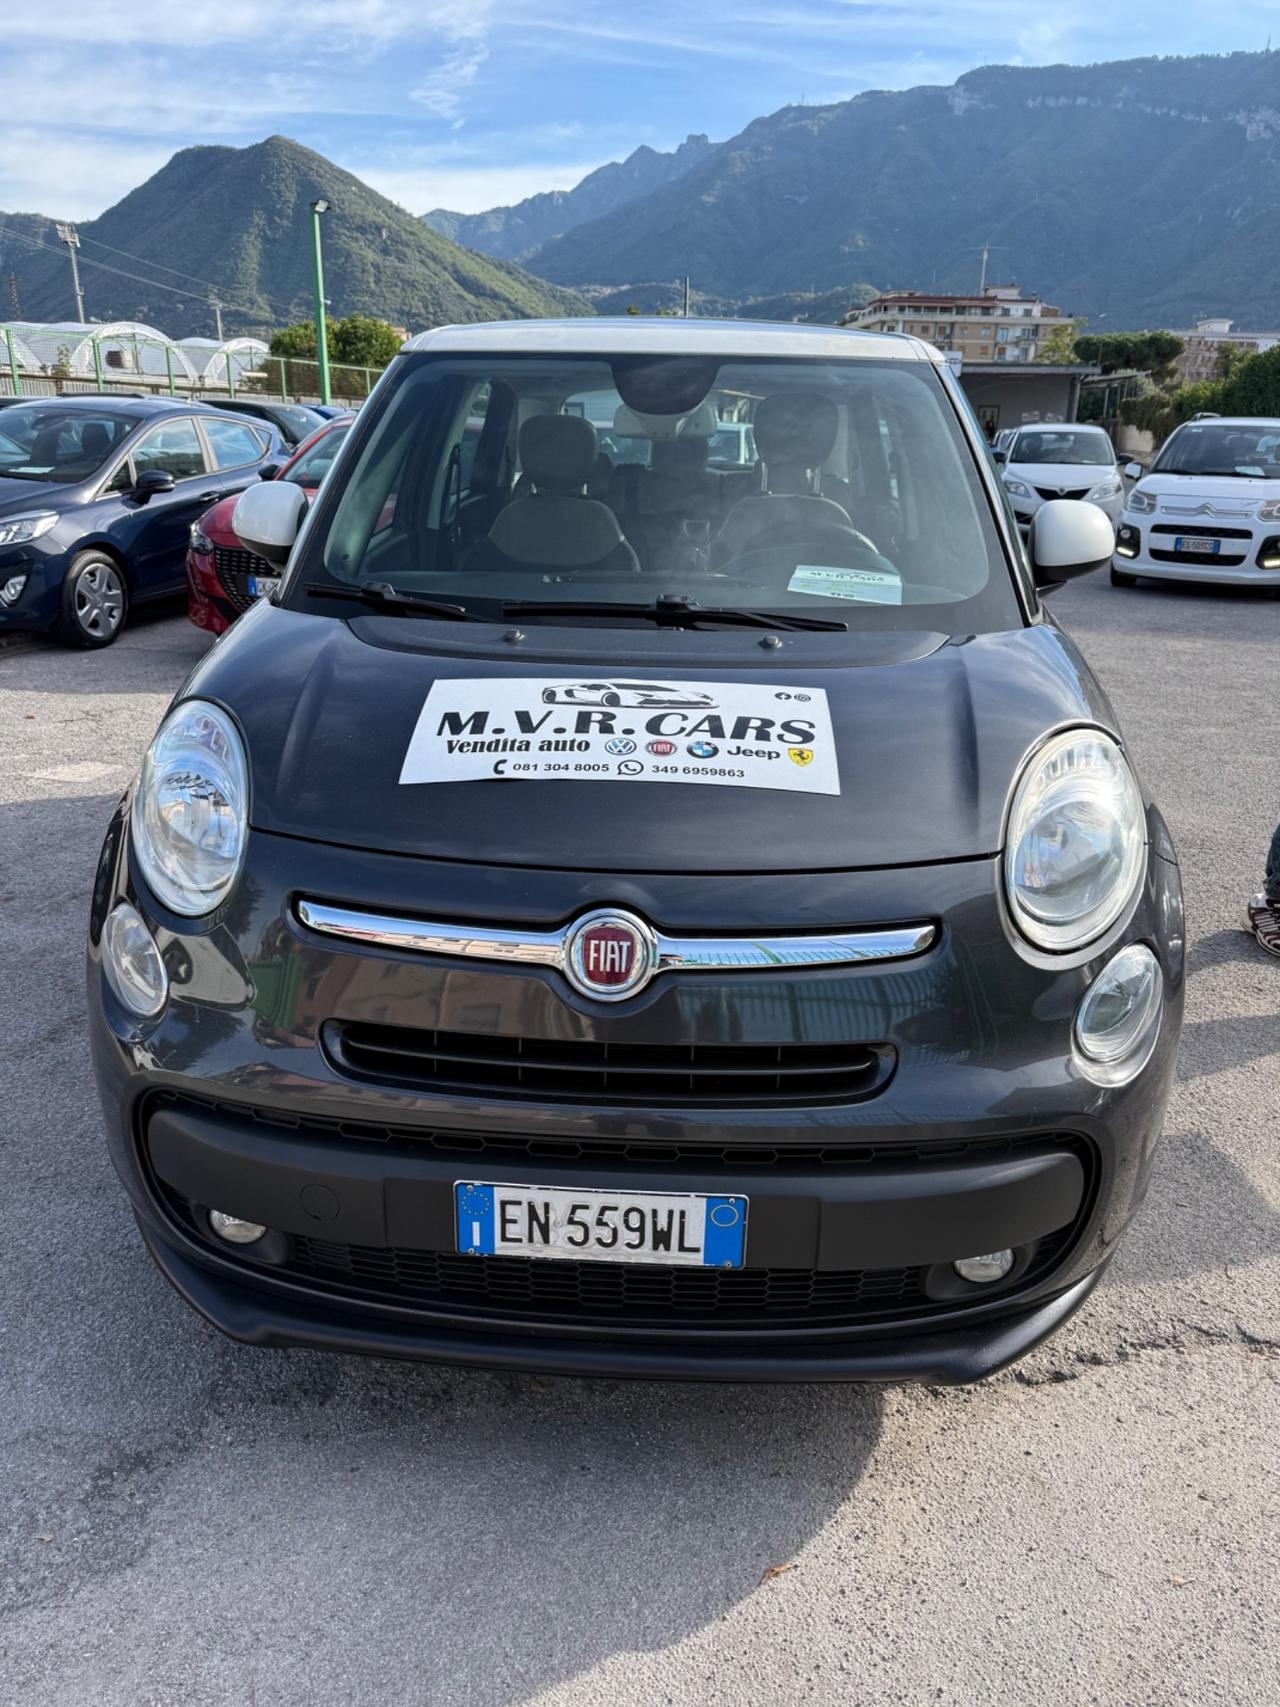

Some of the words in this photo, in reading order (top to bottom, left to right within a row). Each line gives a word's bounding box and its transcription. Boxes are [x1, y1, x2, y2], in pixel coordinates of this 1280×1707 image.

[538, 738, 591, 752] auto
[727, 745, 781, 760] Jeep
[513, 763, 538, 772] 081
[543, 763, 570, 772] 304
[574, 763, 610, 772] 8005
[652, 765, 678, 774] 349
[682, 766, 745, 778] 6959863
[588, 939, 631, 973] FIAT
[500, 1199, 550, 1245] EN
[566, 1203, 701, 1253] 559WL
